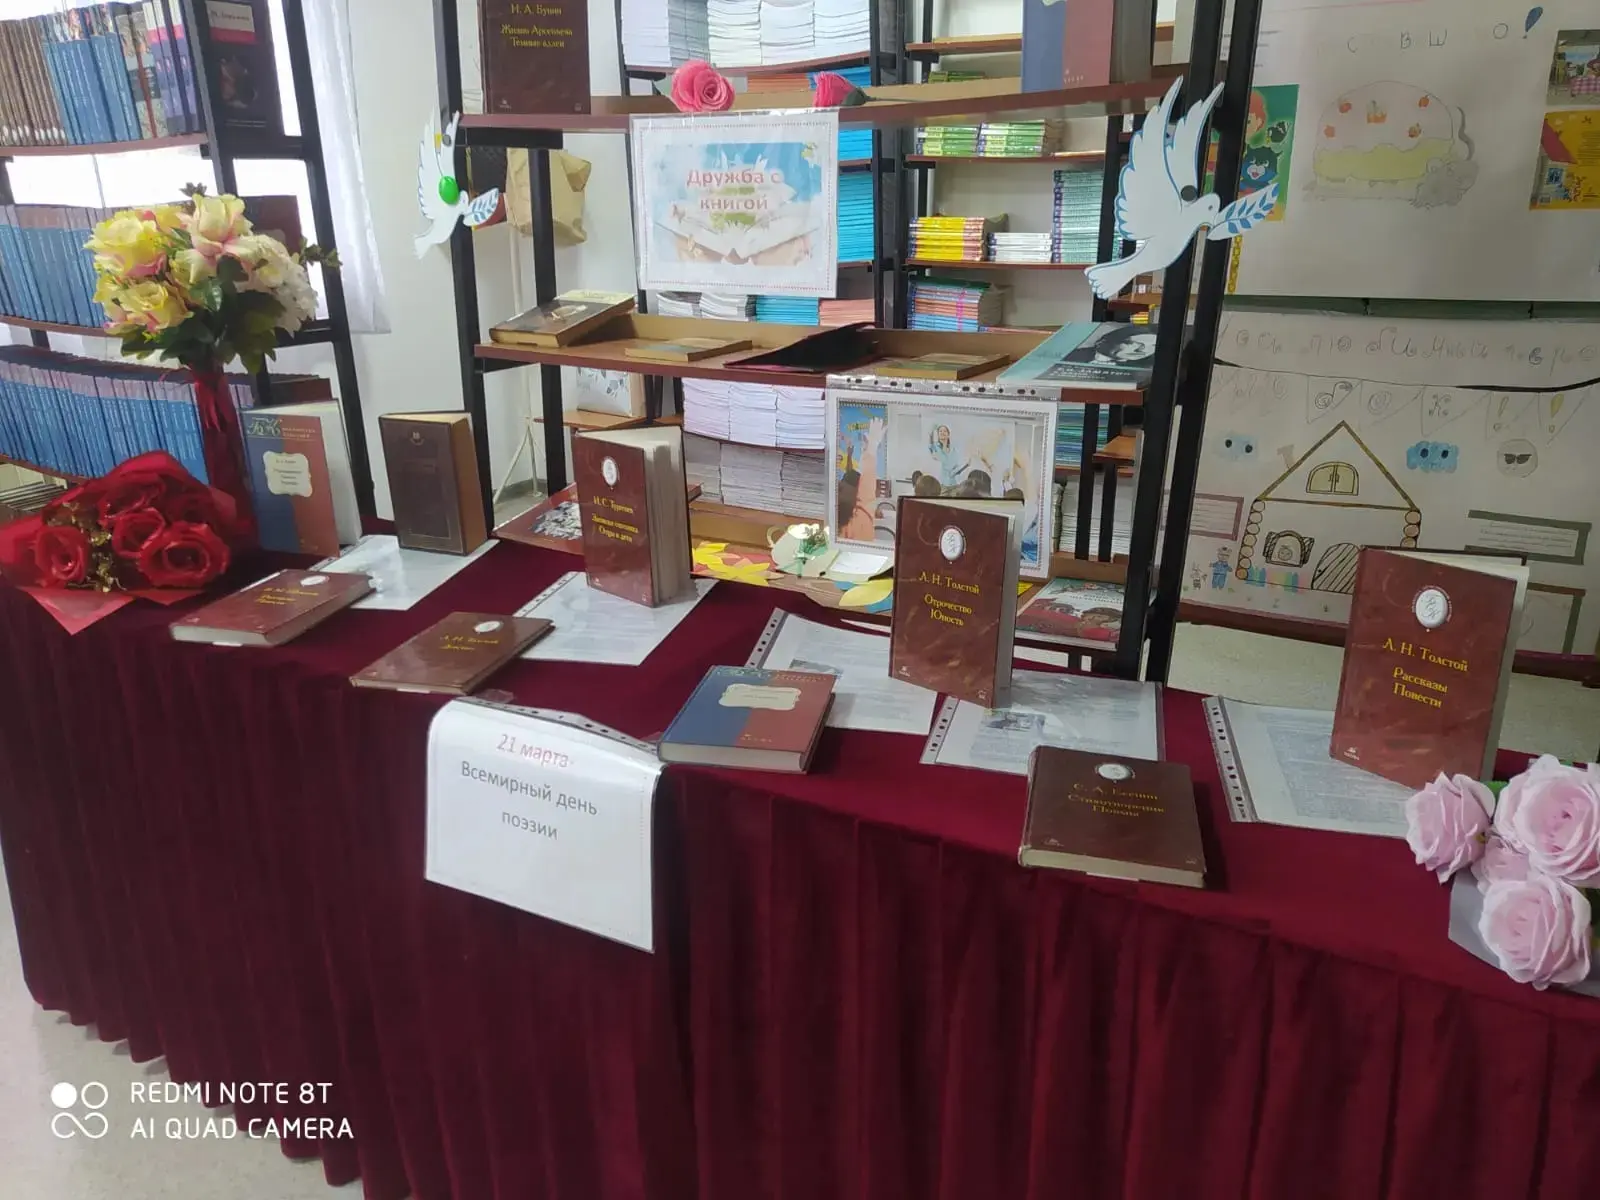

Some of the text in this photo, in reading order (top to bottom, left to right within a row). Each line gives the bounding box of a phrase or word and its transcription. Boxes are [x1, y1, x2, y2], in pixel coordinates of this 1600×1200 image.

[686, 168, 782, 189] Дружба с
[700, 194, 768, 210] книгой
[932, 573, 943, 586] Н.
[945, 576, 981, 595] Толстой
[924, 593, 973, 615] Отрочество
[930, 608, 964, 626] Юность
[1400, 642, 1415, 657] Н.
[1420, 646, 1468, 672] Толстой
[1393, 666, 1448, 693] Рассказы
[1393, 682, 1442, 709] Повести
[496, 734, 517, 754] 21
[461, 760, 598, 816] Всемирный день
[502, 811, 558, 840] поэзии
